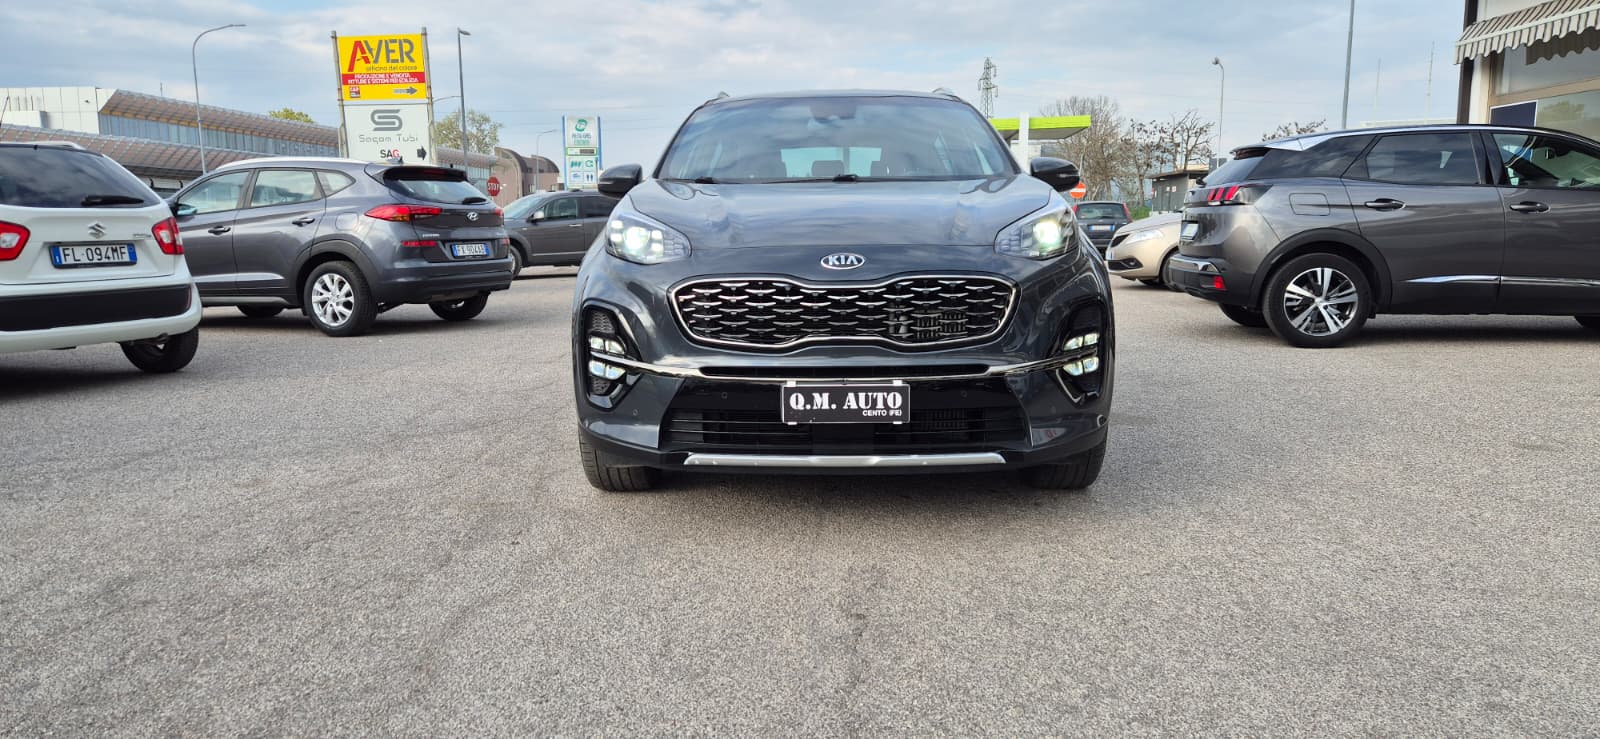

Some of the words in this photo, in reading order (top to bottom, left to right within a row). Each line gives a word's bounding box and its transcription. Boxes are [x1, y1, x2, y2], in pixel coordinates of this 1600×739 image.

[348, 38, 415, 72] AVER
[380, 149, 400, 158] SAG
[828, 255, 858, 265] KIA
[789, 392, 837, 410] Q.M.
[843, 392, 902, 409] AUTO
